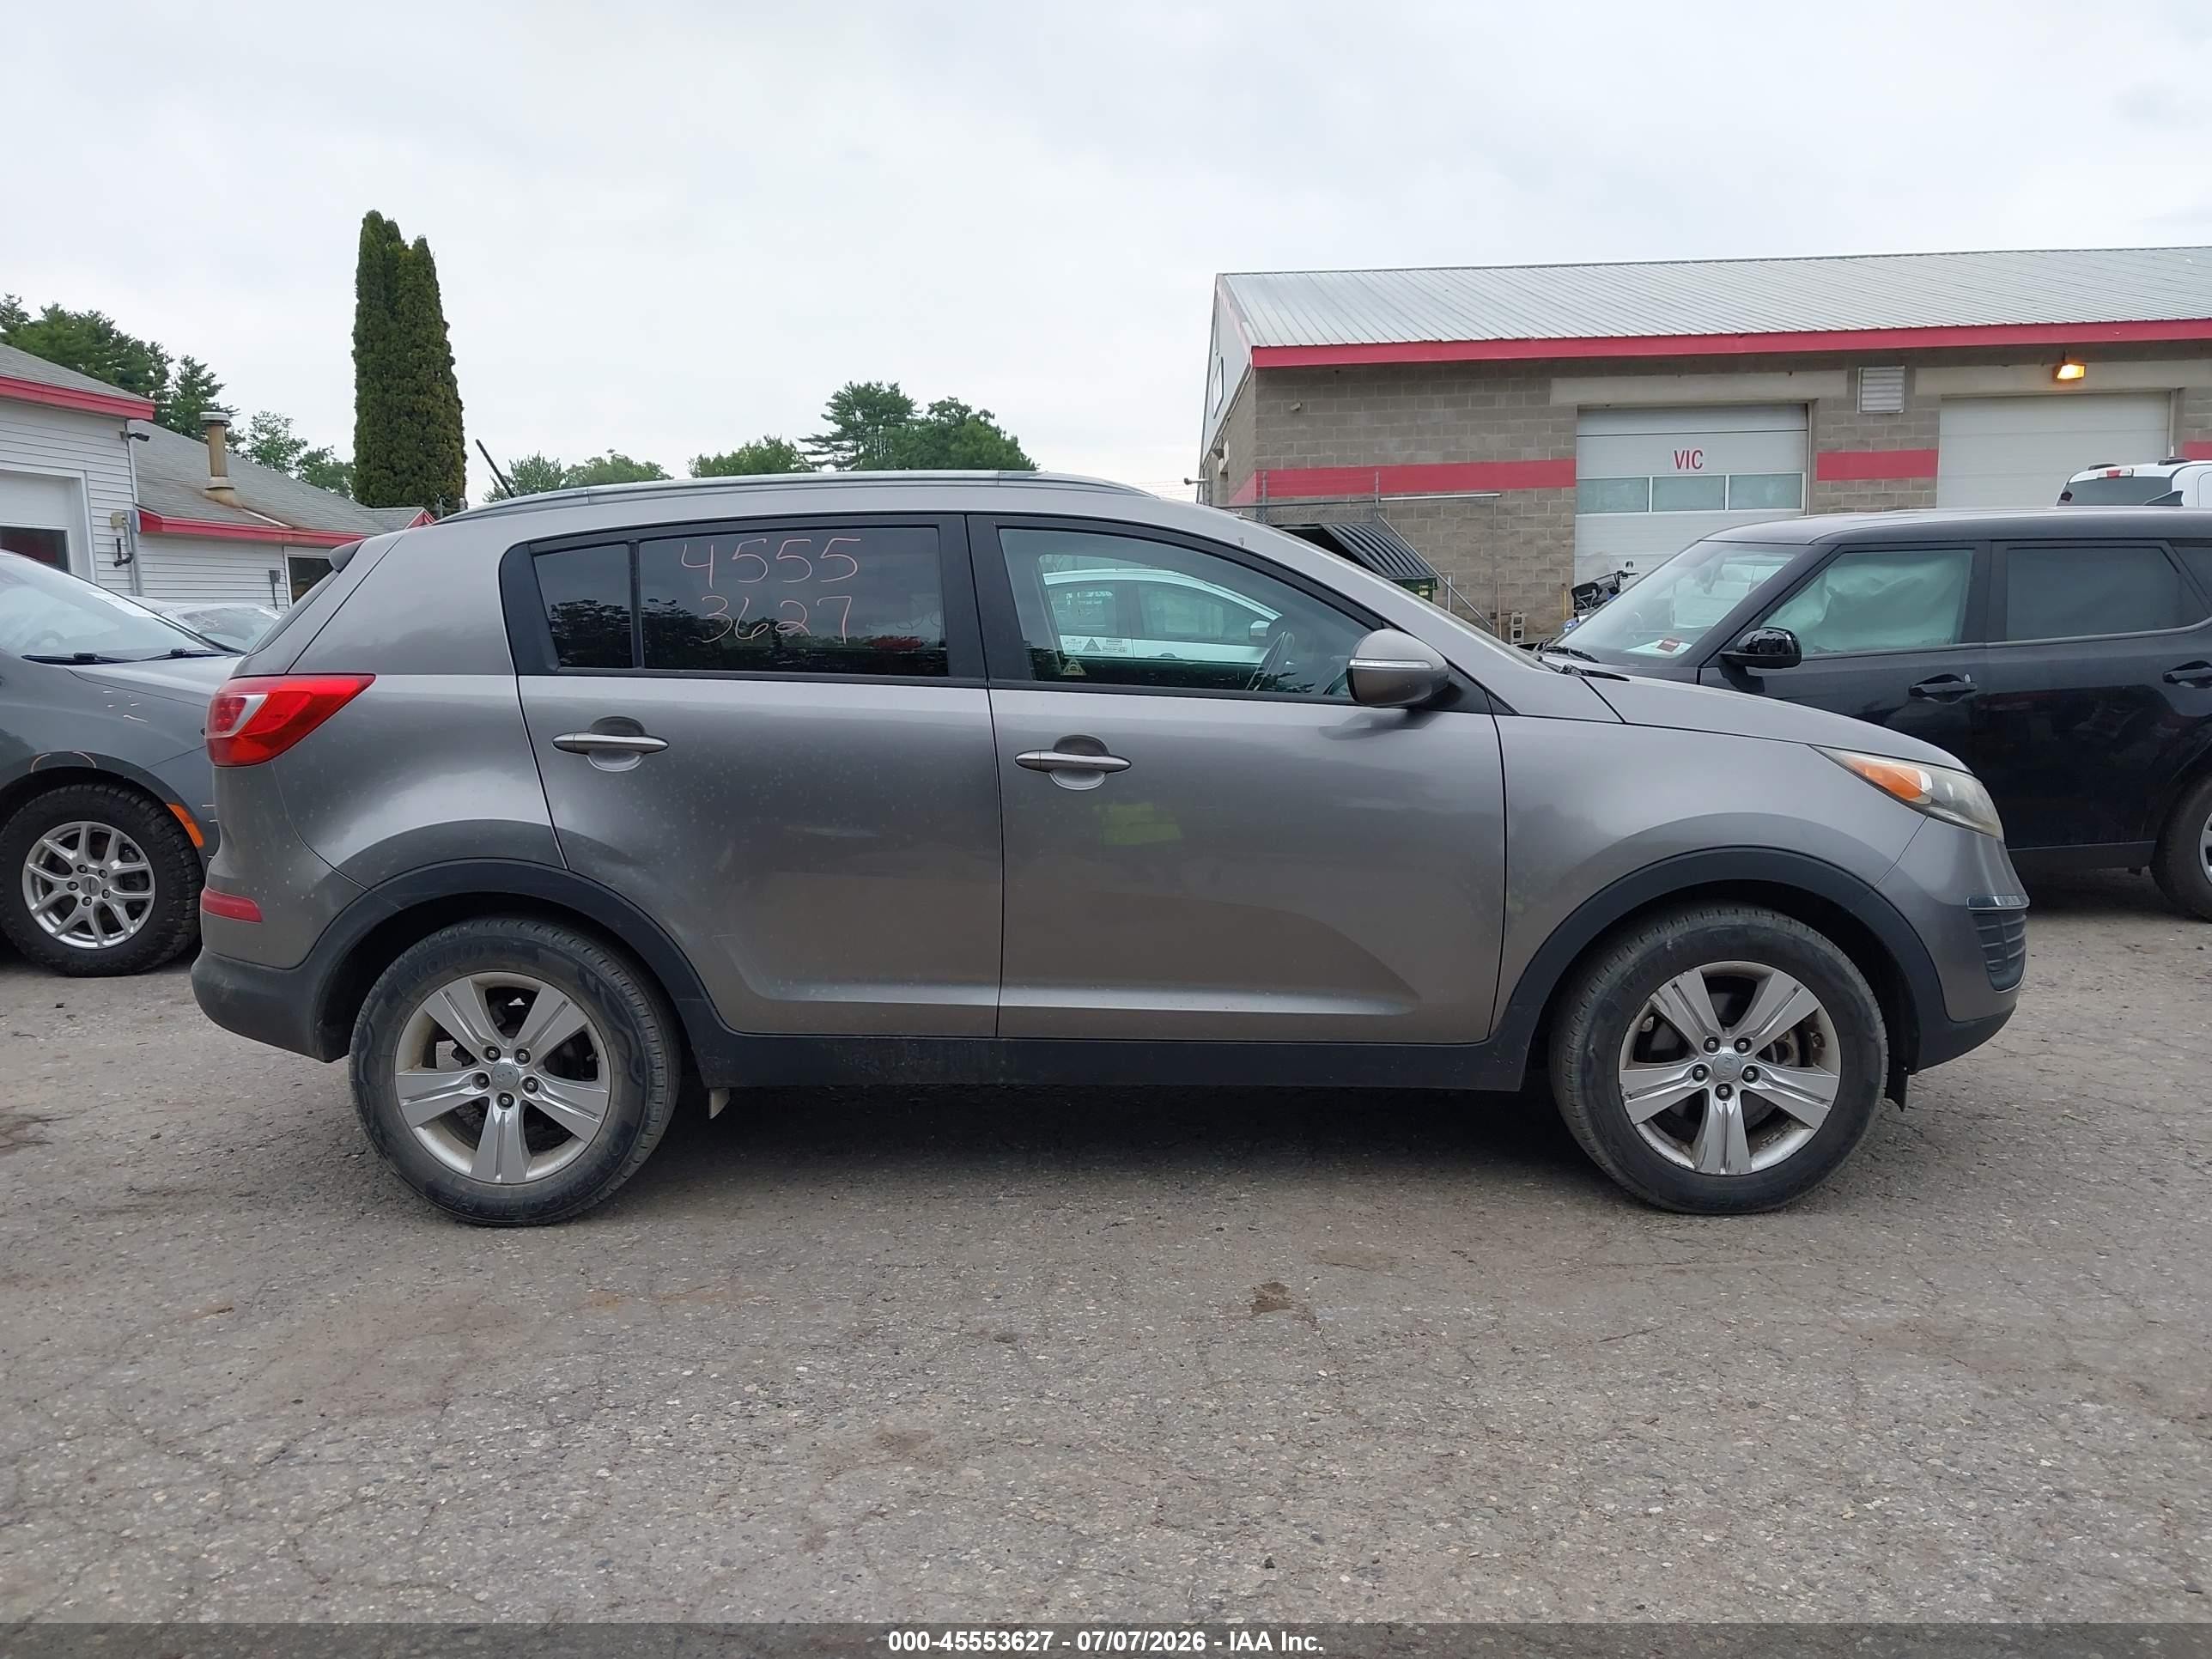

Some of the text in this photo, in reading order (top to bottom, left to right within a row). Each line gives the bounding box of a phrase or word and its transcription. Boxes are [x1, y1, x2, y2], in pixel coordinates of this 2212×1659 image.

[1674, 449, 1704, 471] VIC
[680, 537, 861, 589] 4555
[701, 594, 853, 645] 3627
